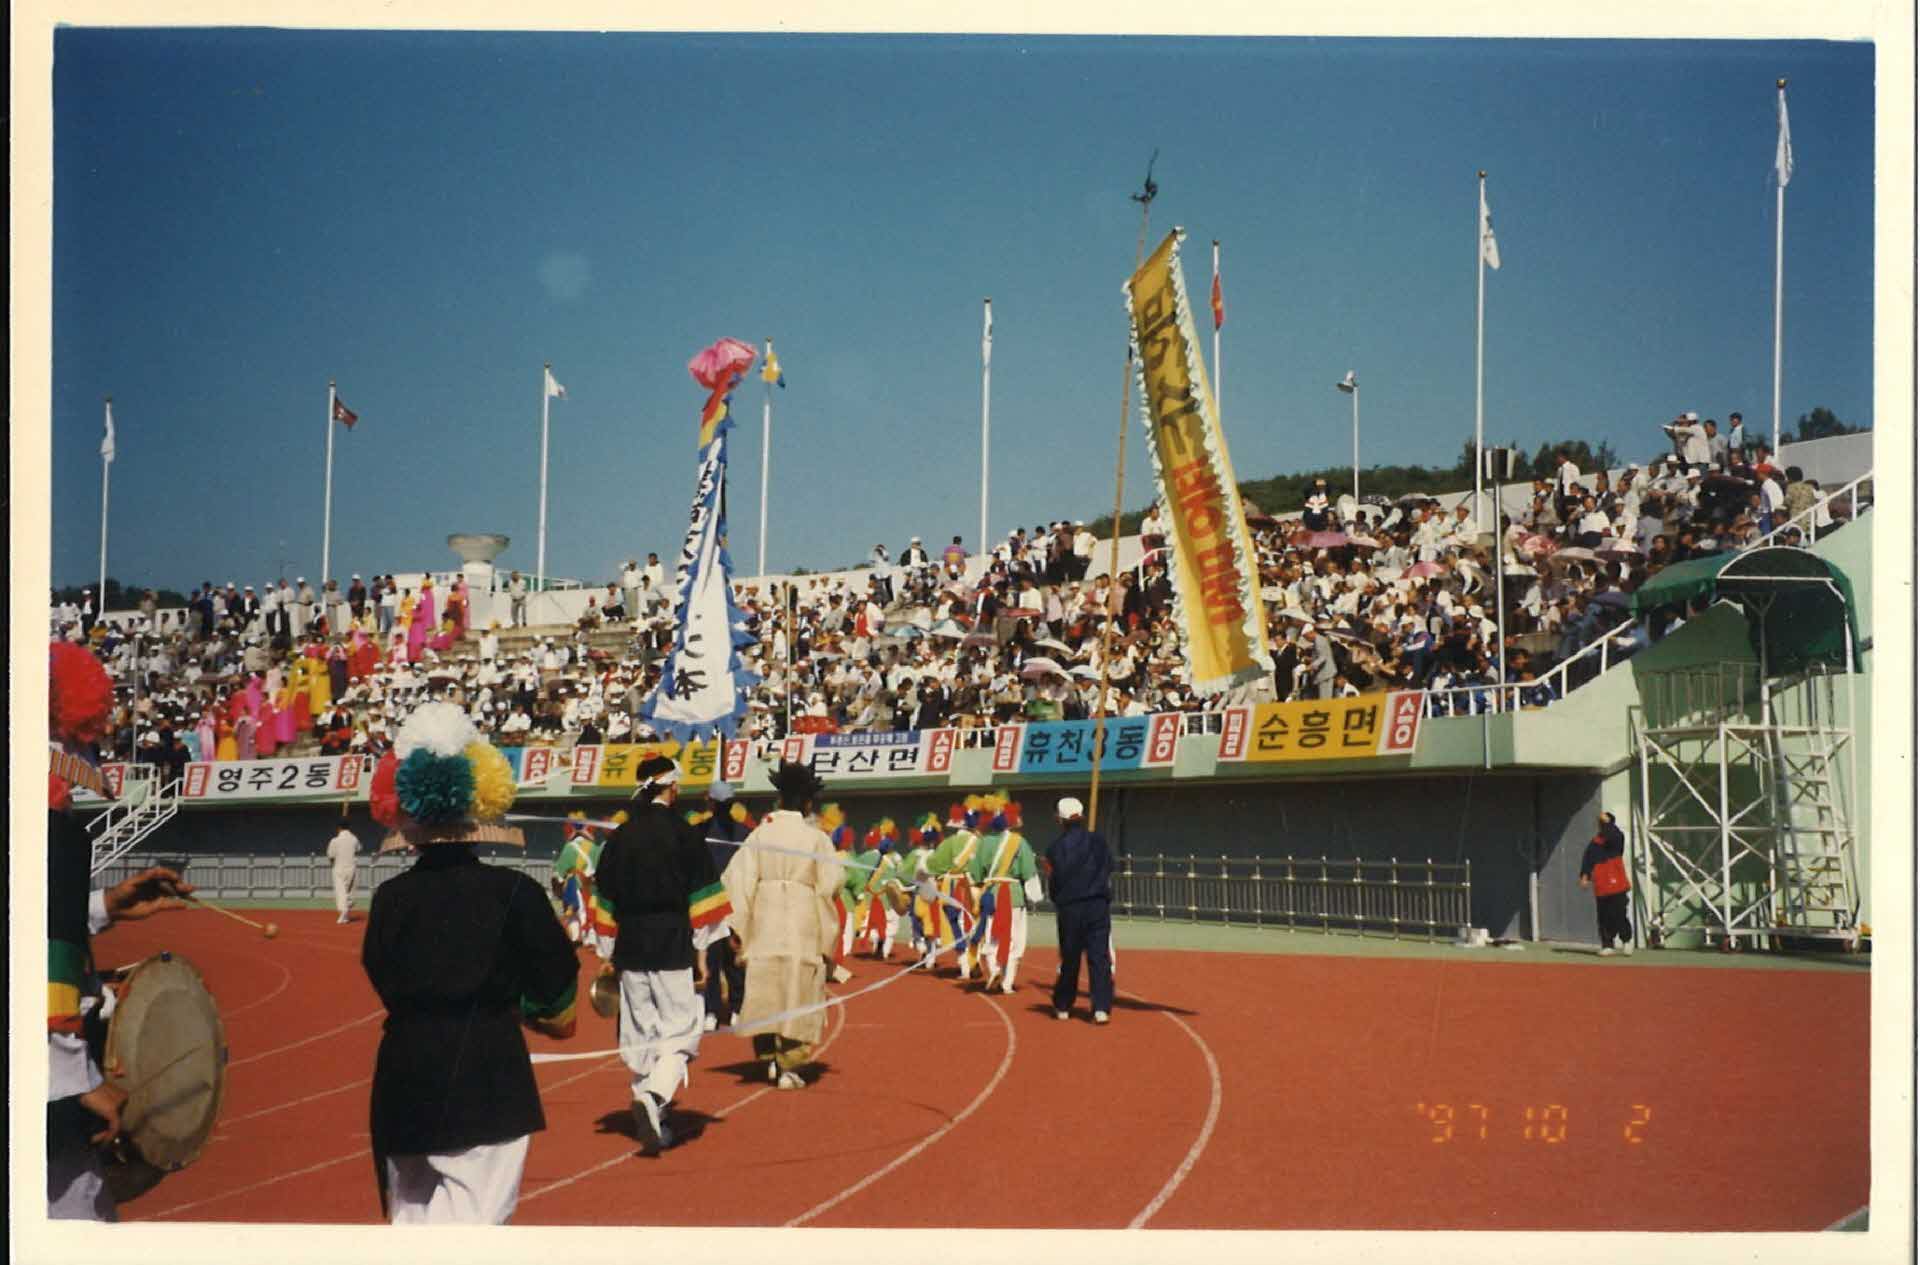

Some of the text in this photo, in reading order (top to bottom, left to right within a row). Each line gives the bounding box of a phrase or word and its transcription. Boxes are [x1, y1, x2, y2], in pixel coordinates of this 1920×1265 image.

[1024, 725, 1145, 763] 휴천3동
[1156, 717, 1174, 758] 승
[1257, 704, 1377, 750] 순흥면
[1395, 697, 1414, 745] 승
[727, 743, 743, 775] 승
[812, 746, 919, 773] 단산면
[933, 733, 950, 769] 승
[217, 762, 331, 792] 영주2동
